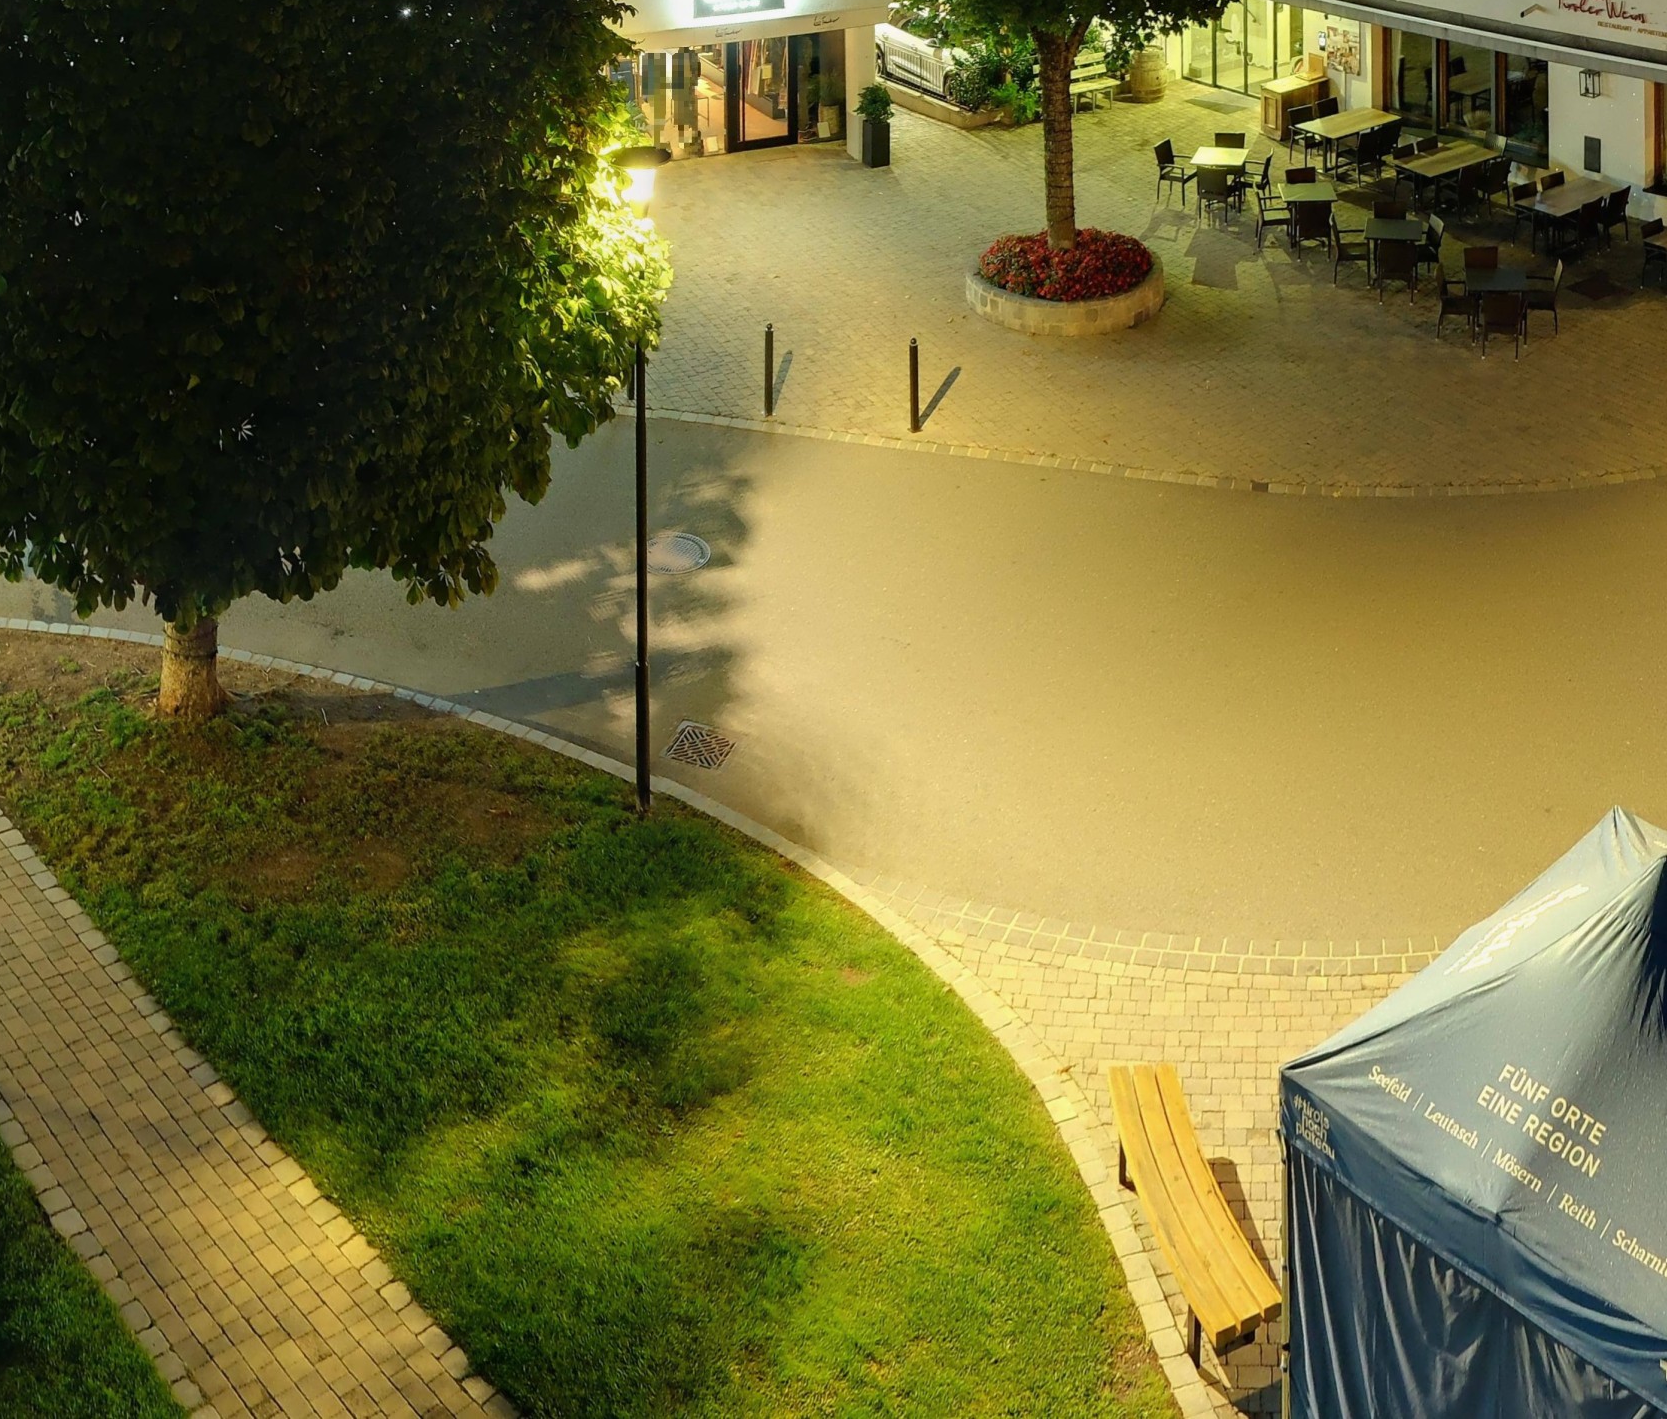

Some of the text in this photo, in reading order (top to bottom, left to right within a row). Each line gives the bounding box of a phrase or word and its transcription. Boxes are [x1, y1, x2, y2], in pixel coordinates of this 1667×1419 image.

[1293, 1093, 1330, 1131] #tirols
[1301, 1109, 1328, 1144] hoch
[1476, 1084, 1602, 1179] EINE REGION
[1498, 1063, 1608, 1146] FÜNF ORTE
[1295, 1121, 1336, 1160] plateau
[1367, 1064, 1413, 1104] Seefeld
[1423, 1101, 1479, 1150] Leutasch
[1492, 1147, 1543, 1194] Mösern
[1557, 1192, 1598, 1231] Reith
